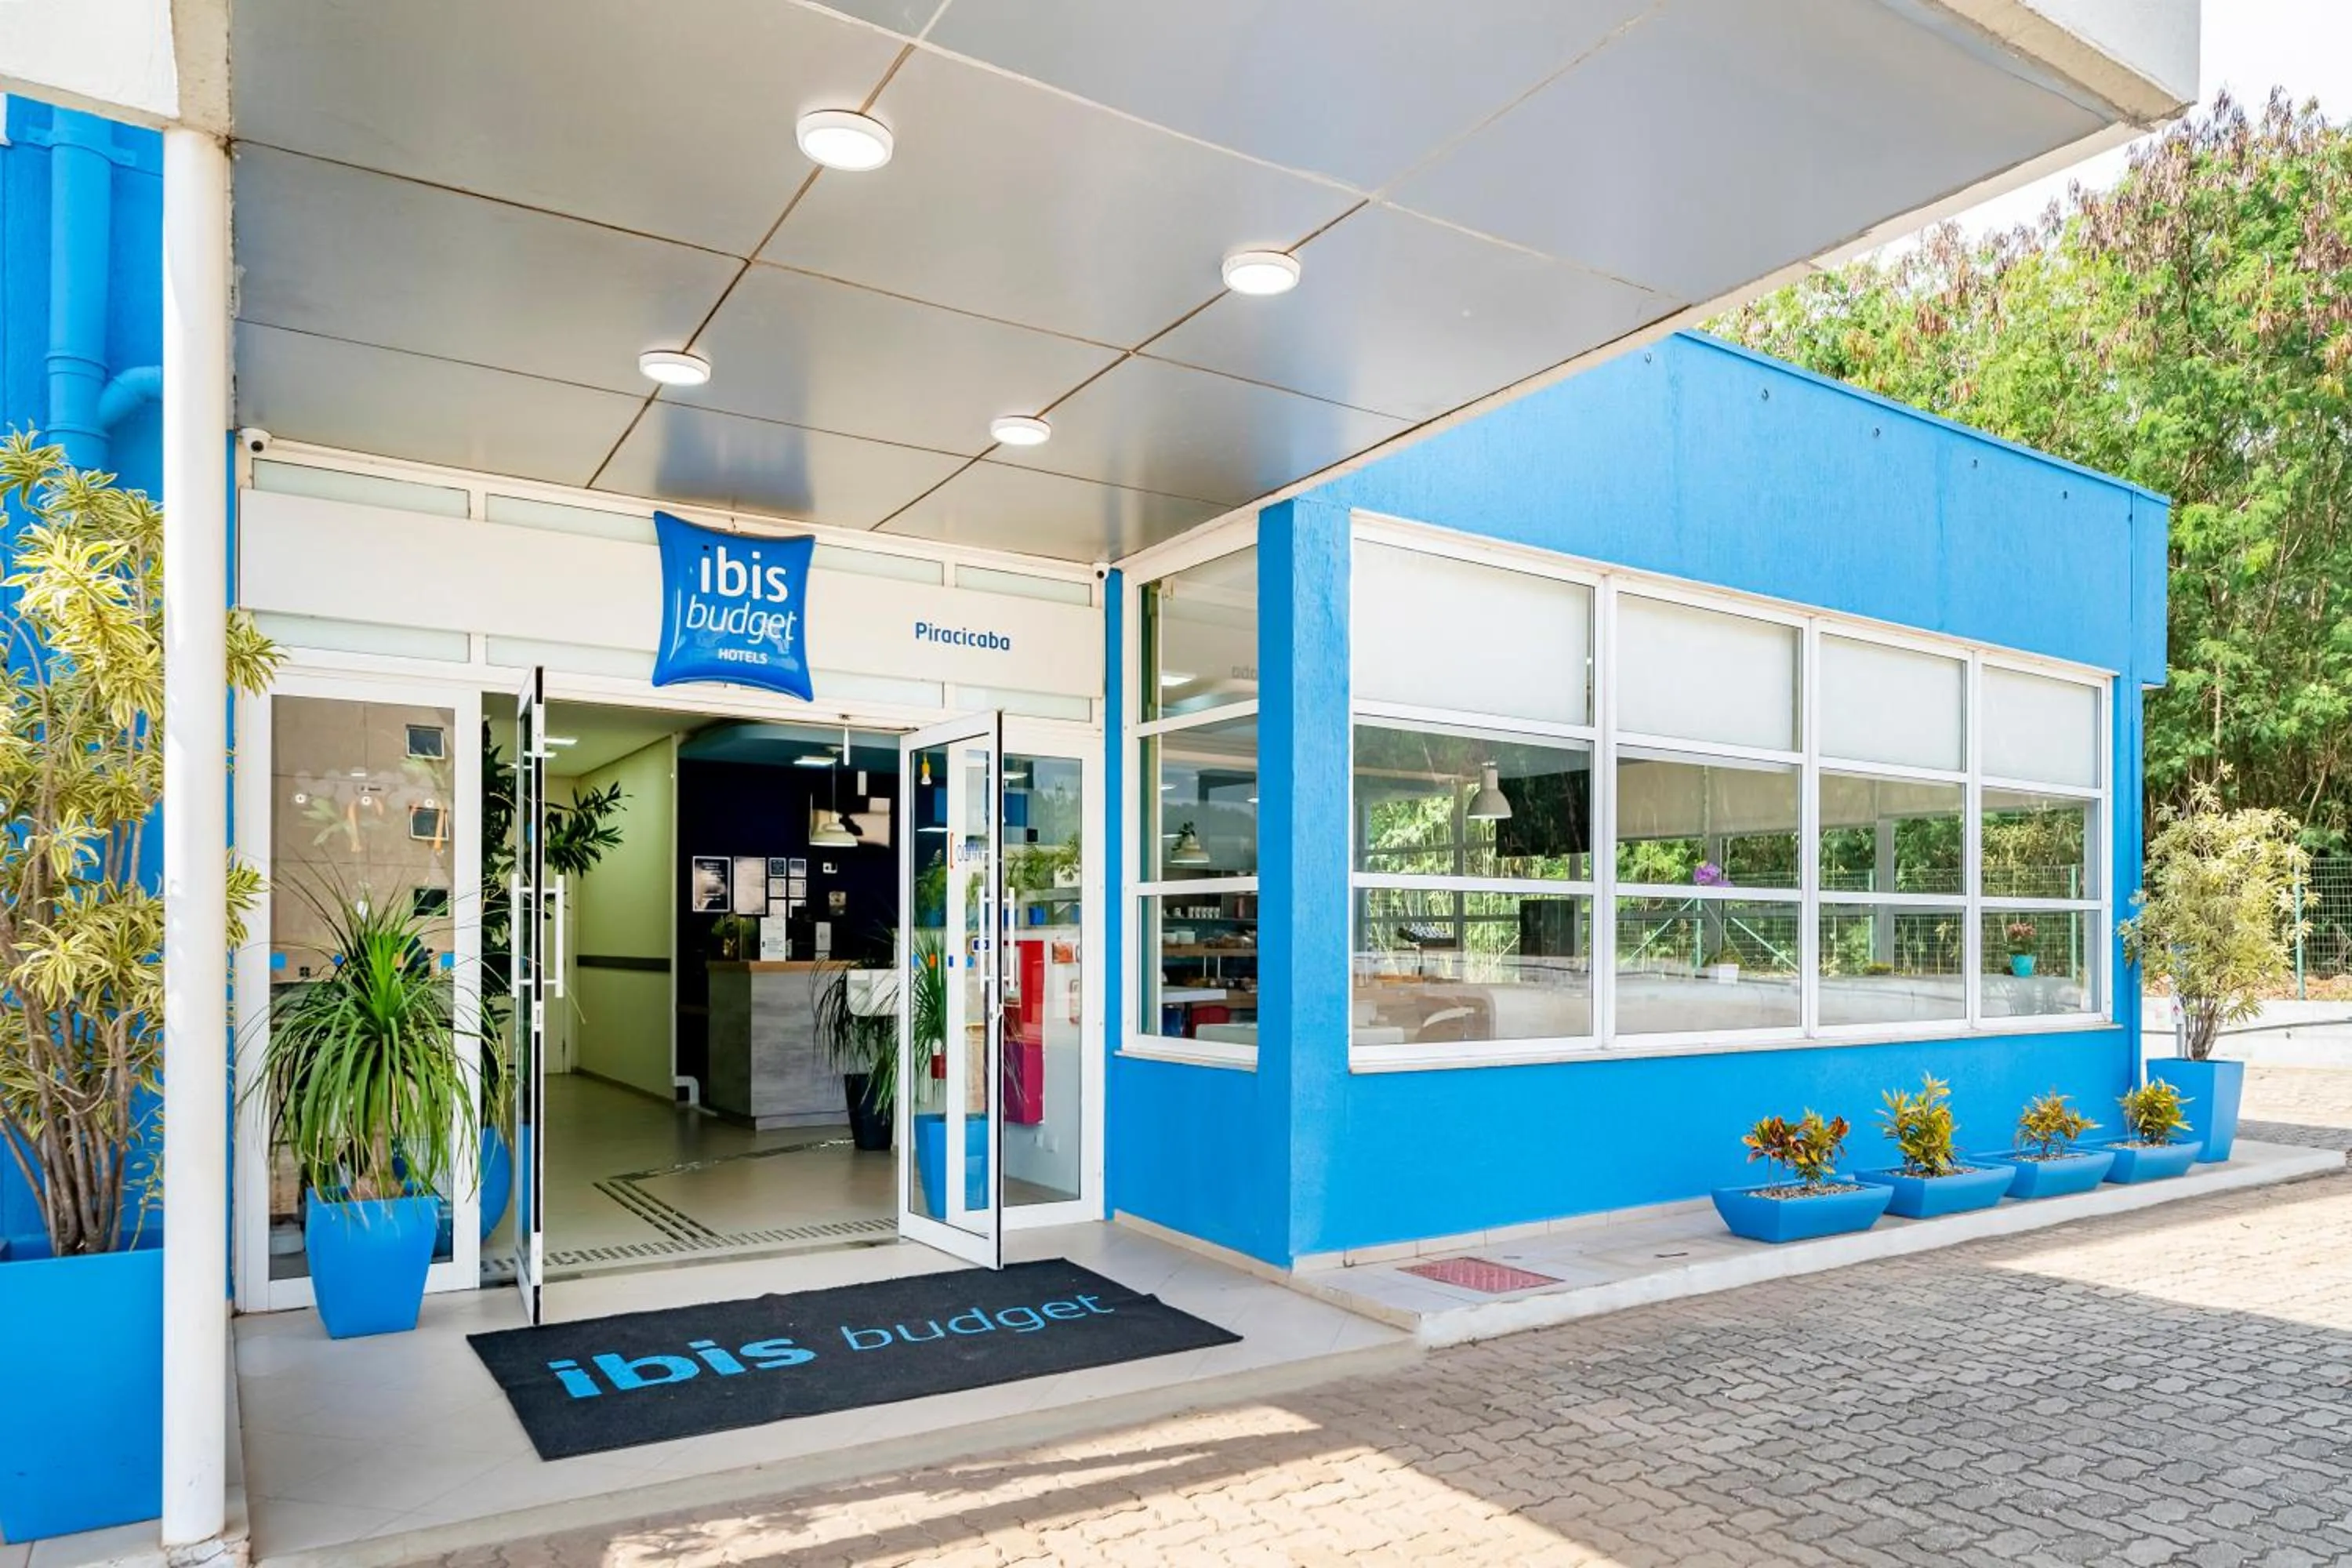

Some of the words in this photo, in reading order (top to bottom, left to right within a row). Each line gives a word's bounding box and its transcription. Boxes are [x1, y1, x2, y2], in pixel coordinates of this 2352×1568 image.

[700, 545, 789, 603] ibis
[686, 593, 797, 644] budget
[915, 622, 1011, 652] Piracicaba
[717, 648, 768, 665] HOTELS
[546, 1338, 818, 1399] ibis
[841, 1293, 1114, 1351] budget
